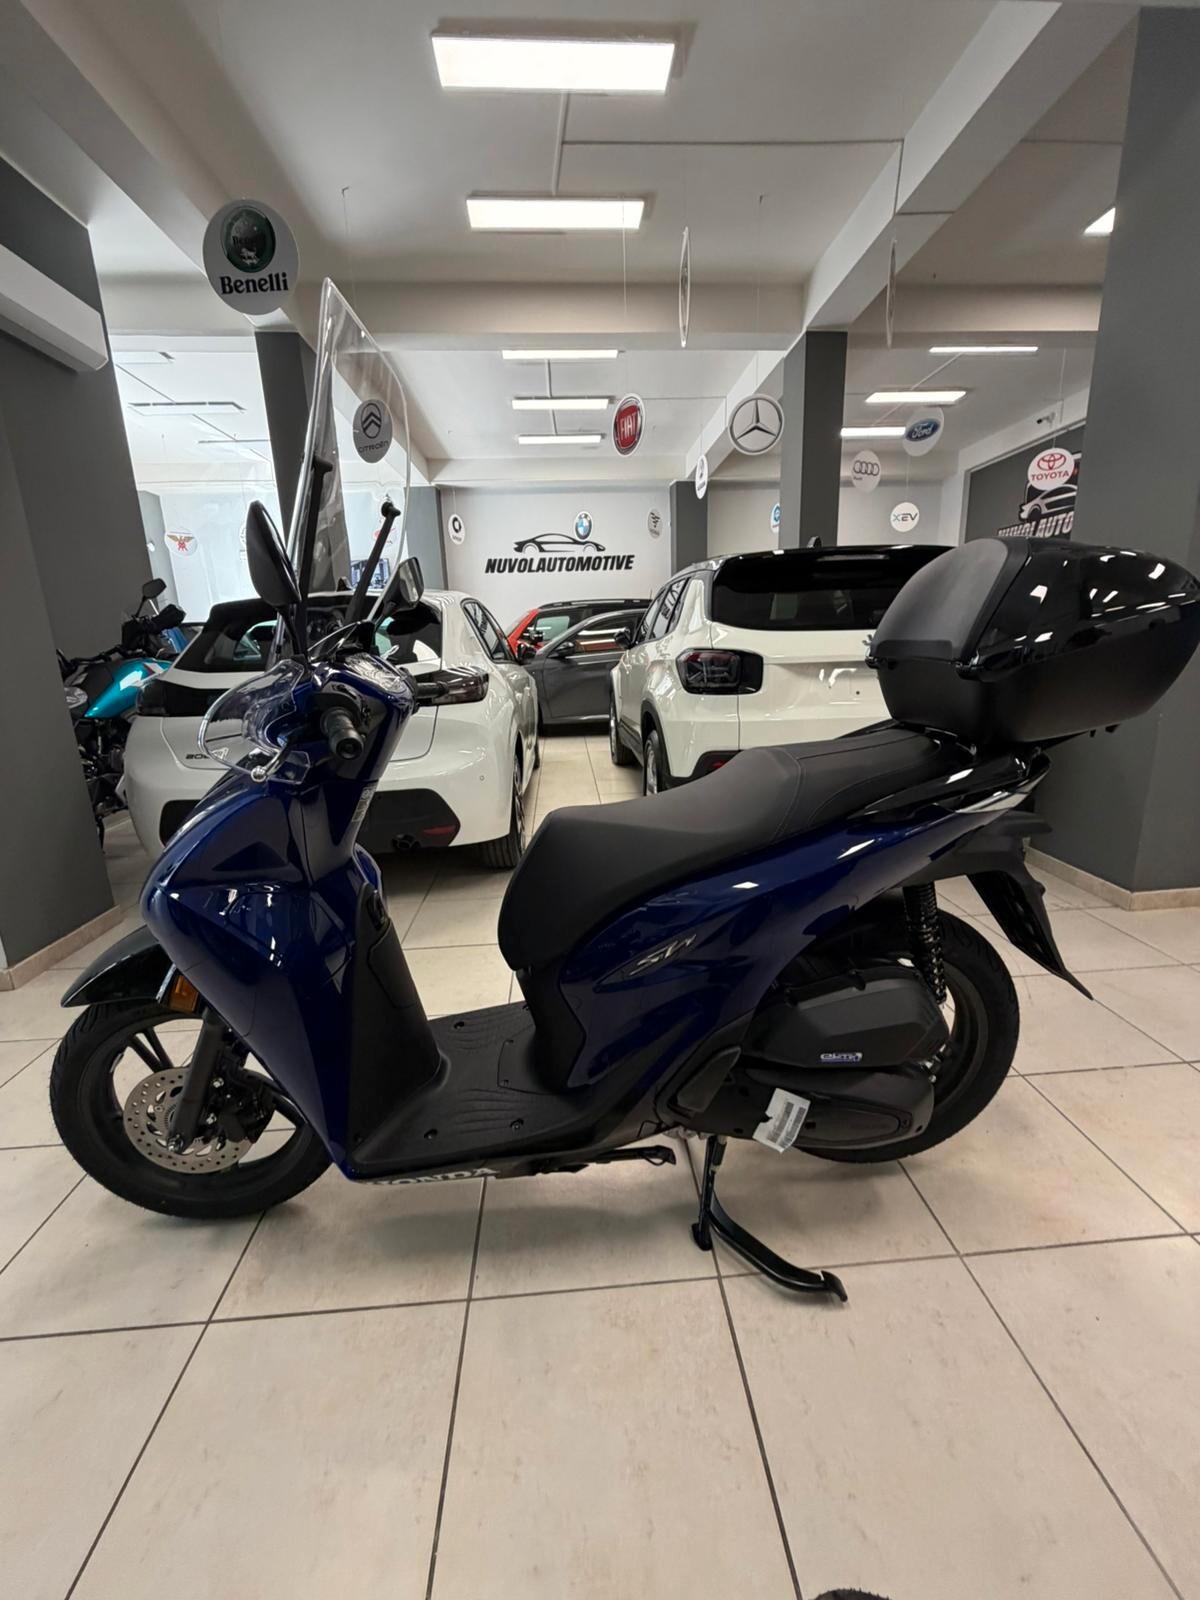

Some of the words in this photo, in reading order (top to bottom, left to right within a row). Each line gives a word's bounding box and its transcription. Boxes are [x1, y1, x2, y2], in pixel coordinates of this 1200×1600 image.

[220, 272, 288, 294] Benelli
[620, 412, 637, 441] FIAT
[911, 422, 935, 439] Ford
[1031, 470, 1069, 481] TOYOTA
[892, 513, 918, 522] XEV
[485, 554, 635, 574] NUVOLAUTOMOTIVE
